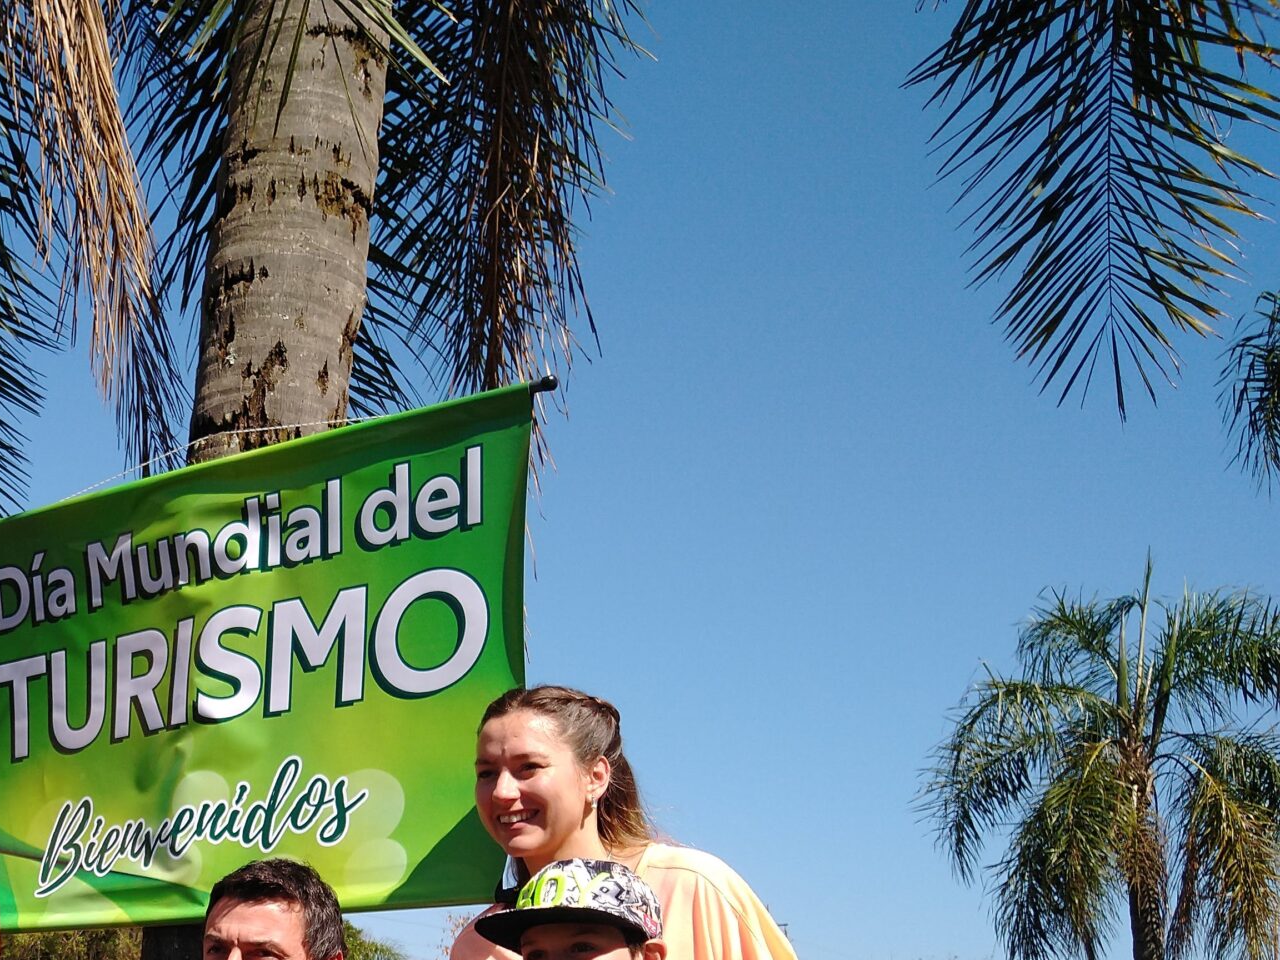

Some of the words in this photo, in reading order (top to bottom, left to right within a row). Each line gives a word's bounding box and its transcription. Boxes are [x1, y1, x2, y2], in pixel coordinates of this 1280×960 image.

[85, 476, 342, 609] Mundial
[356, 444, 484, 551] del
[33, 754, 369, 898] Bienvenidos
